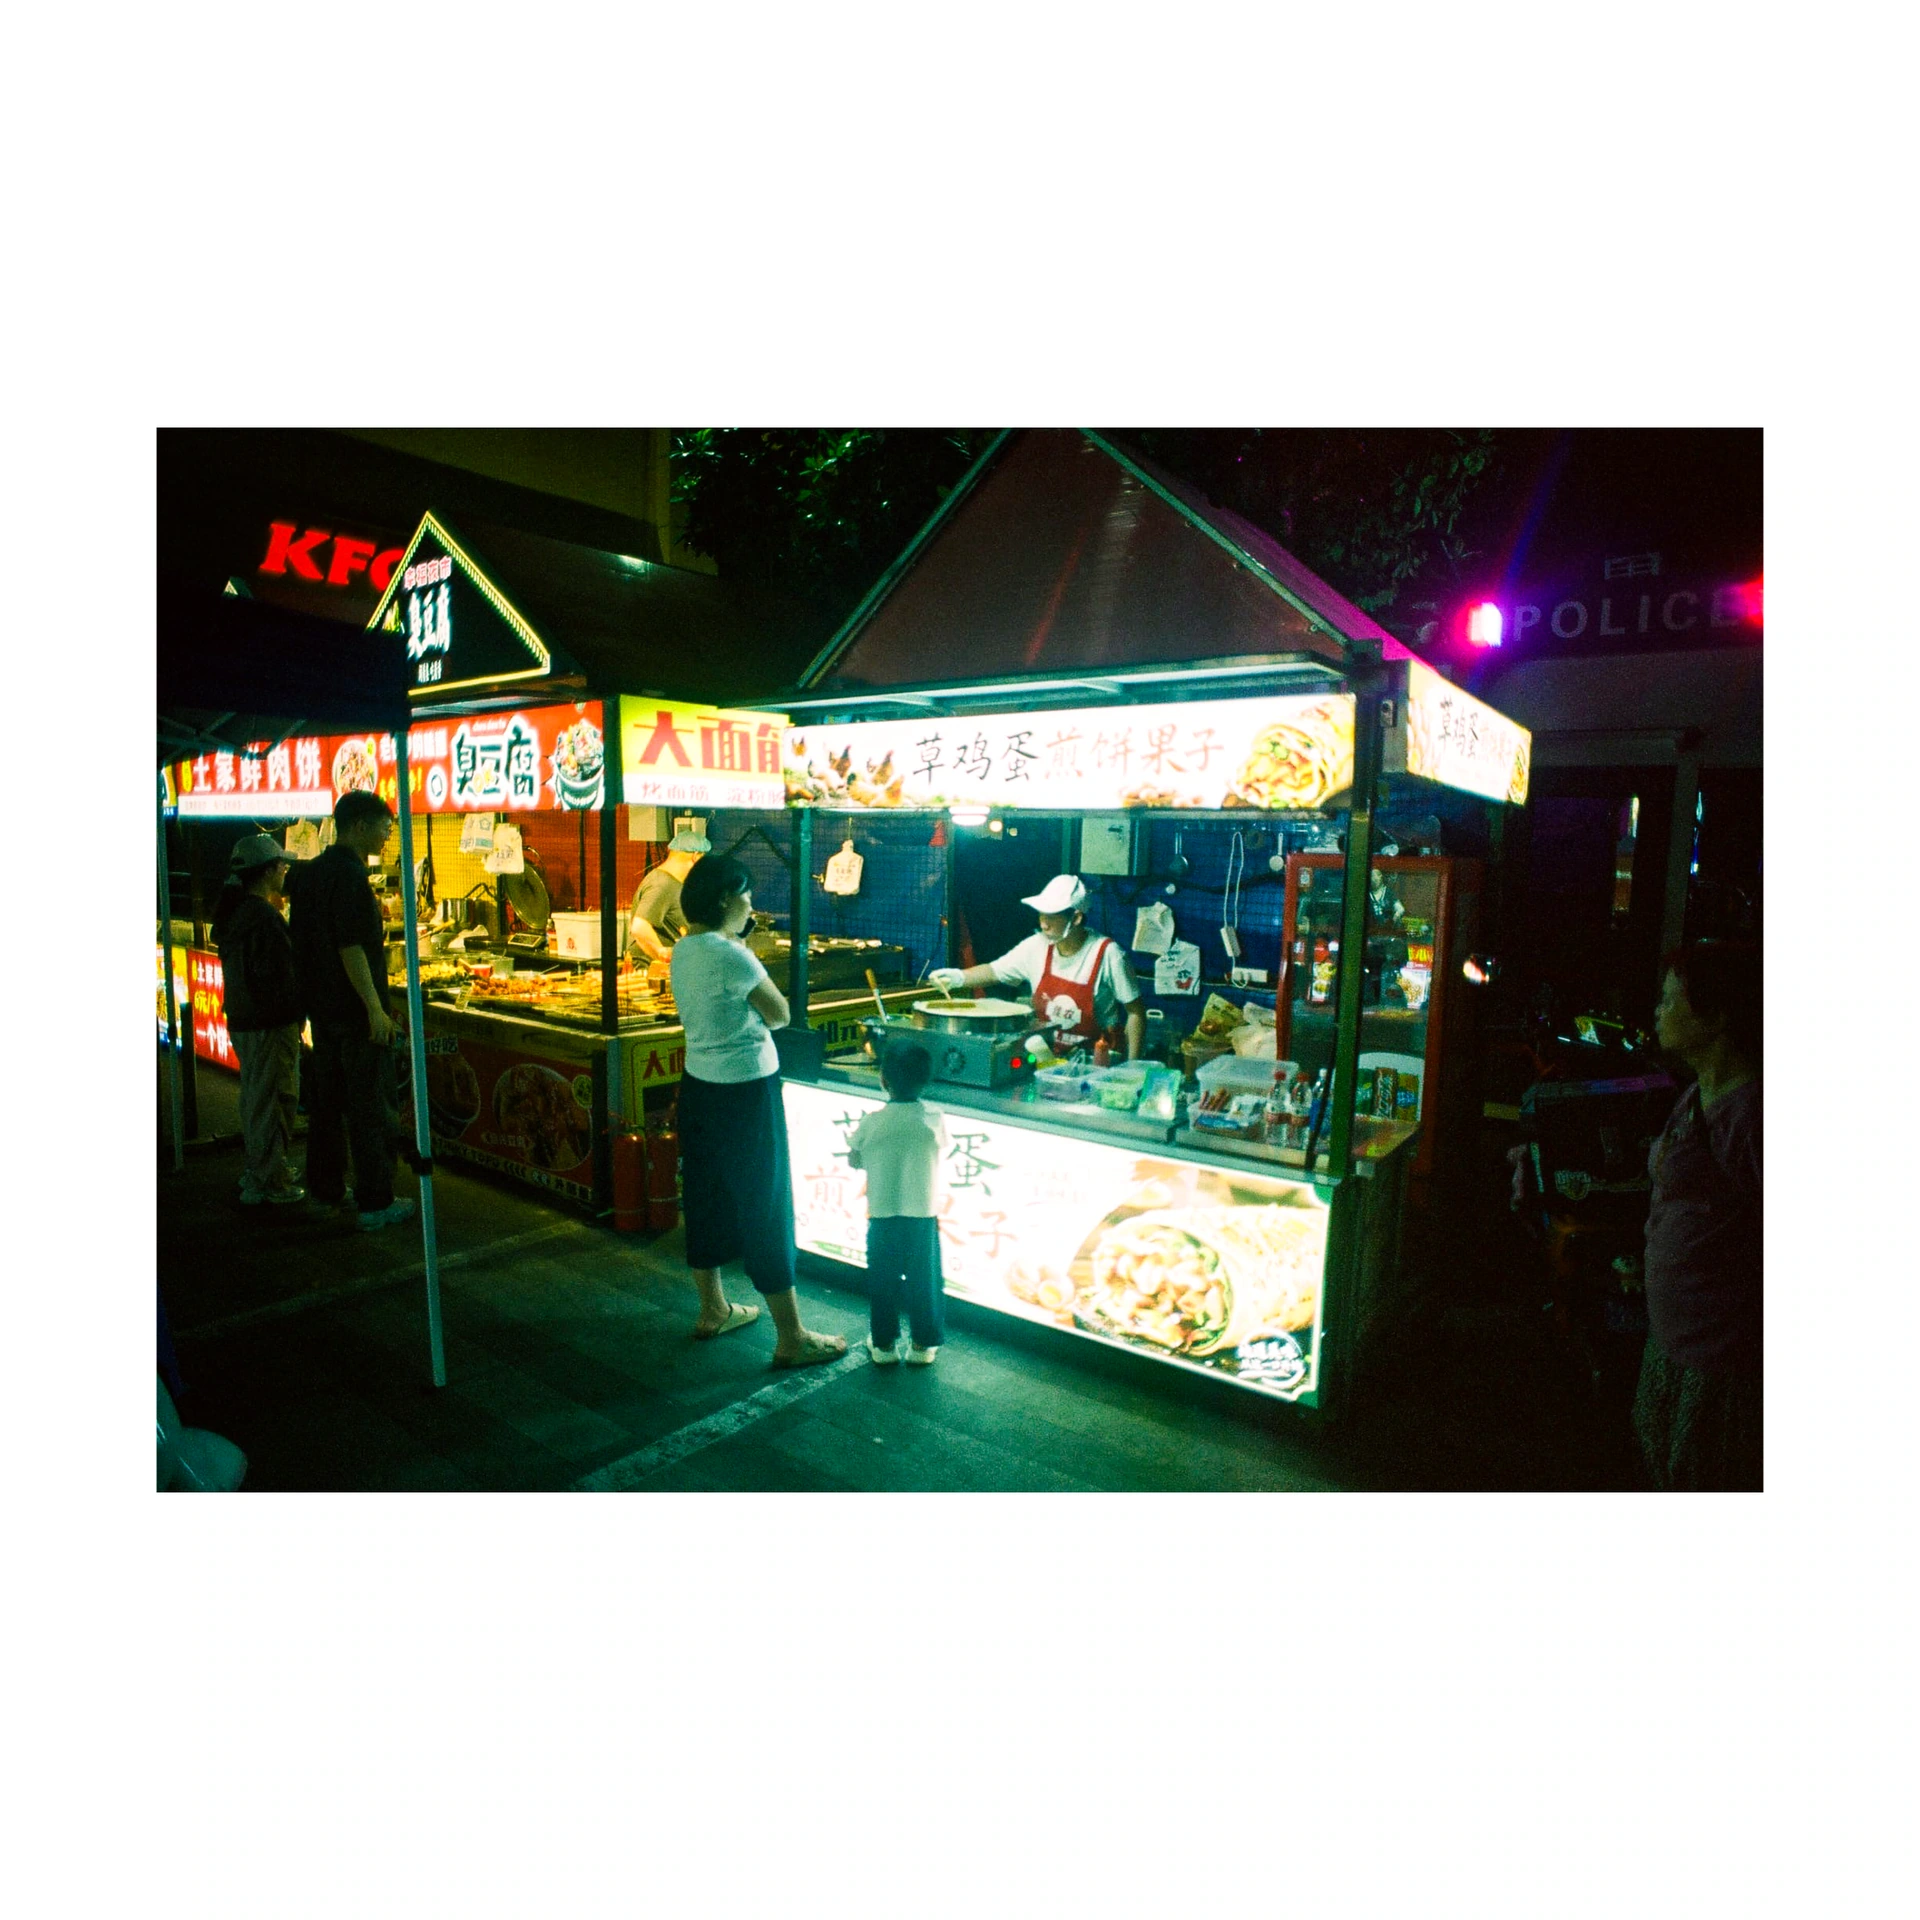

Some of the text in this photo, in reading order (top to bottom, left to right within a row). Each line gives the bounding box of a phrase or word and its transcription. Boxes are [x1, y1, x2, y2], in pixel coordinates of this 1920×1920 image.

[407, 582, 451, 659] 臭豆腐
[1513, 588, 1740, 642] POLICE
[455, 723, 535, 796] 臭豆腐
[913, 723, 1224, 785] 草鸡蛋煎饼果子
[803, 1164, 1019, 1259] 煎子
